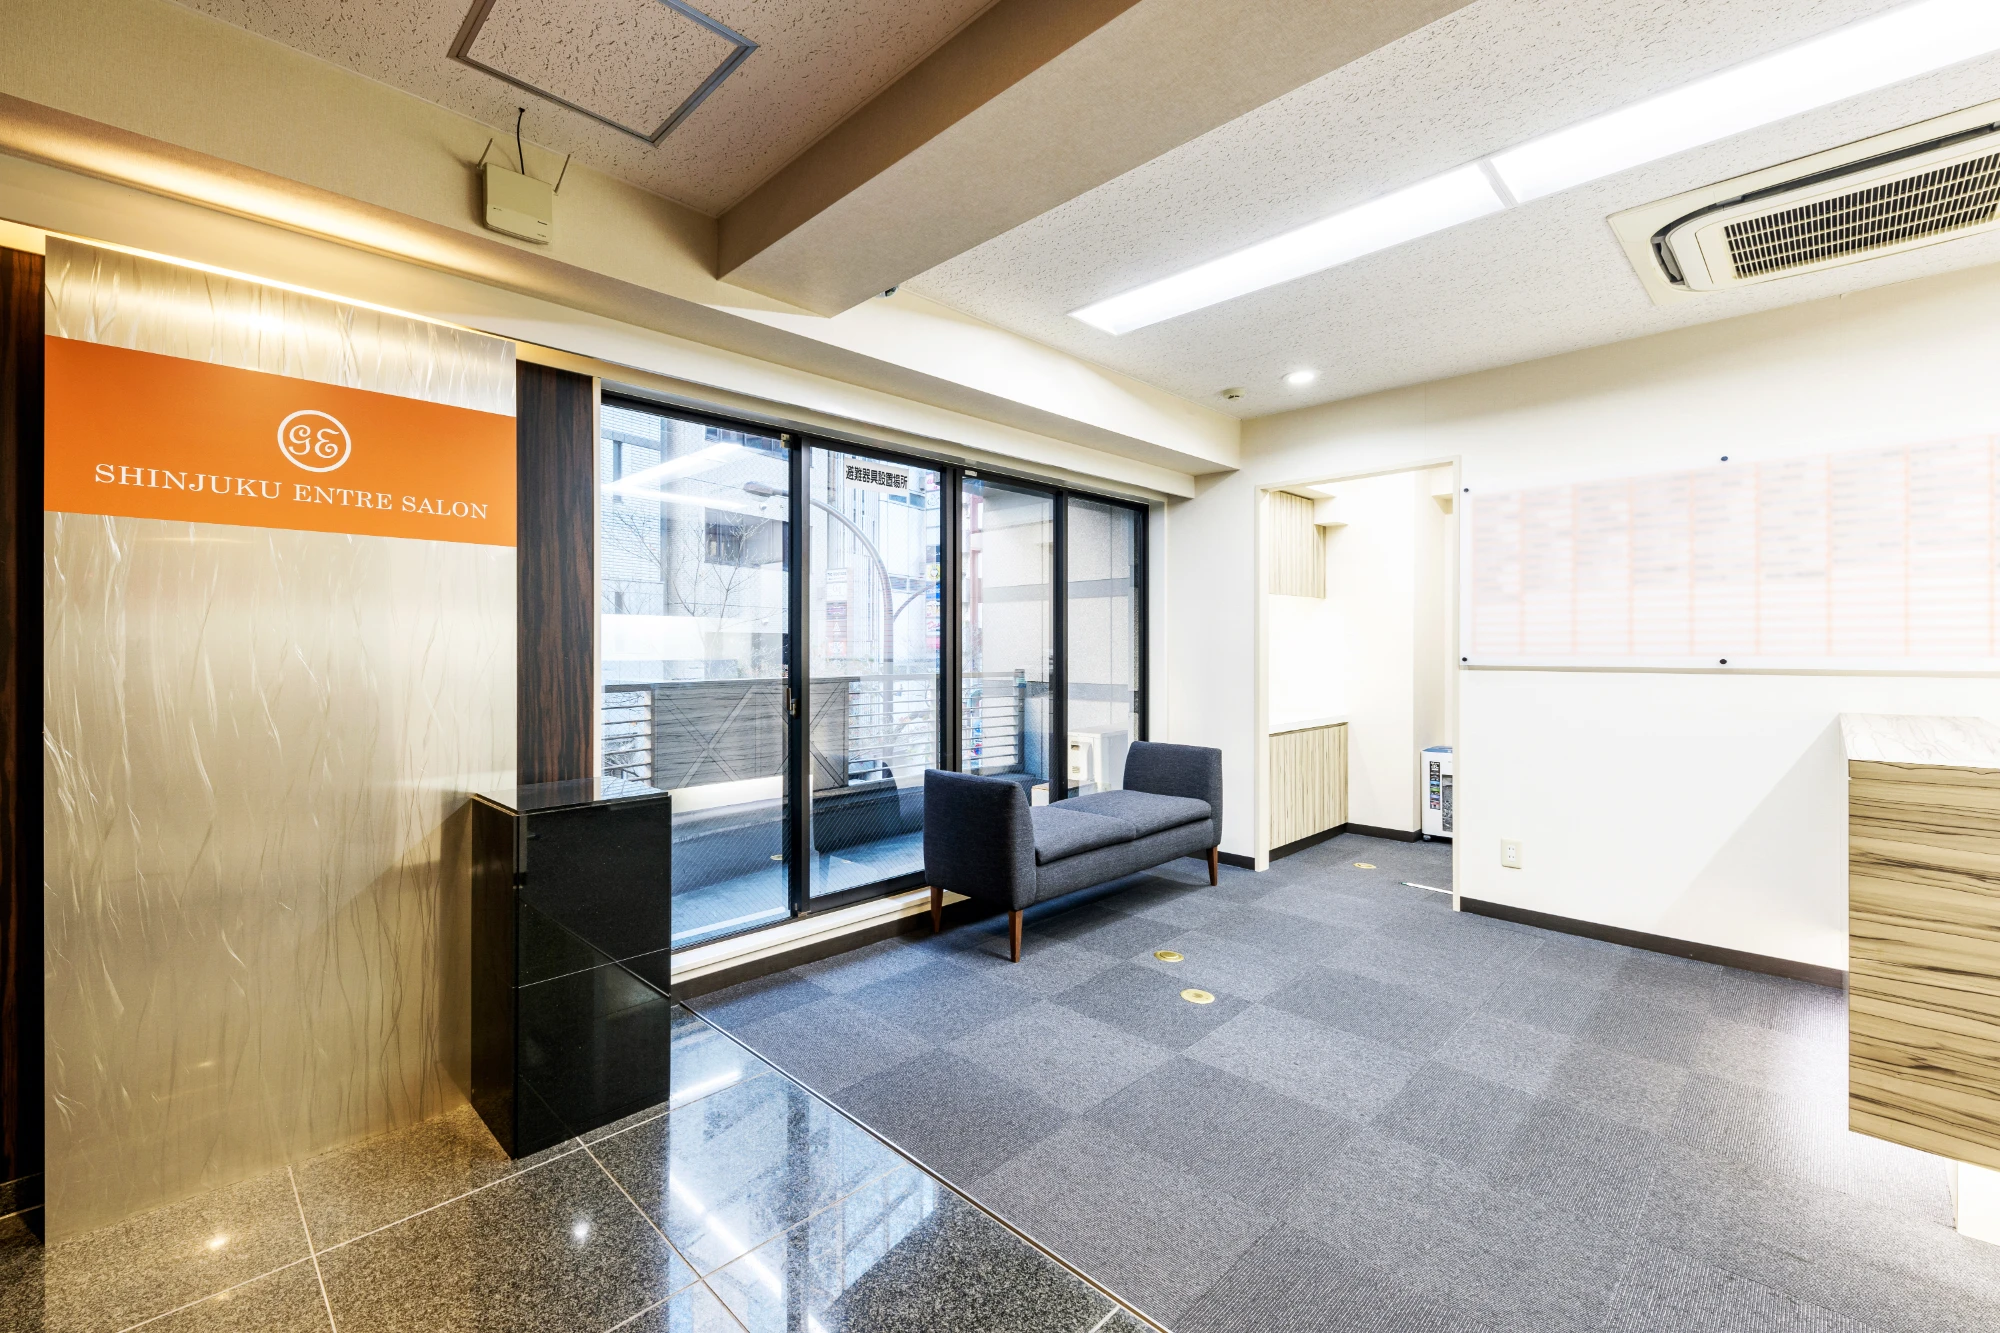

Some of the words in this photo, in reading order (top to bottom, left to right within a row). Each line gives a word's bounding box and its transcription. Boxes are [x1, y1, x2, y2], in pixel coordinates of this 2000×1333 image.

[95, 463, 282, 499] SHINJUKU
[293, 484, 392, 511] ENTRE
[401, 495, 488, 520] SALON
[845, 464, 908, 490] 避難器具設置場所
